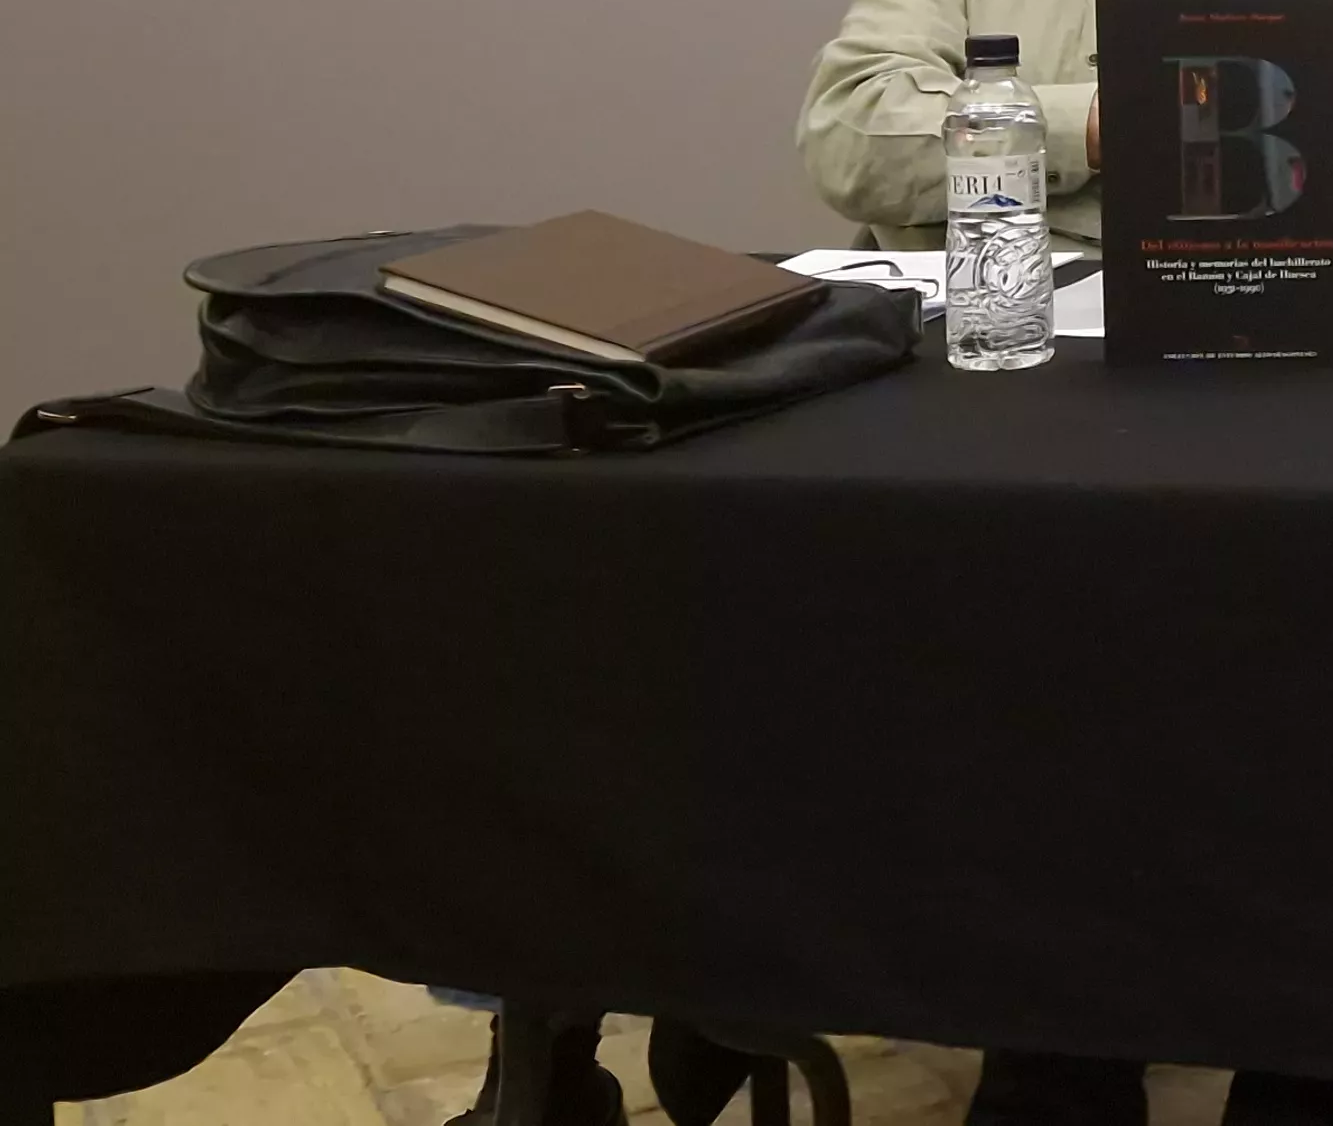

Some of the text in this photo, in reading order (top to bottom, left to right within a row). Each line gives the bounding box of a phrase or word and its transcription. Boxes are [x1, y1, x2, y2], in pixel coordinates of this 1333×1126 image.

[1162, 56, 1307, 221] B
[1146, 256, 1332, 272] Historia y memorias del bachillerato
[1161, 274, 1174, 282] en
[1176, 270, 1186, 281] el
[1227, 272, 1233, 283] y
[1235, 269, 1263, 282] Cajal
[1264, 269, 1278, 280] de
[1280, 268, 1318, 280] Huesca
